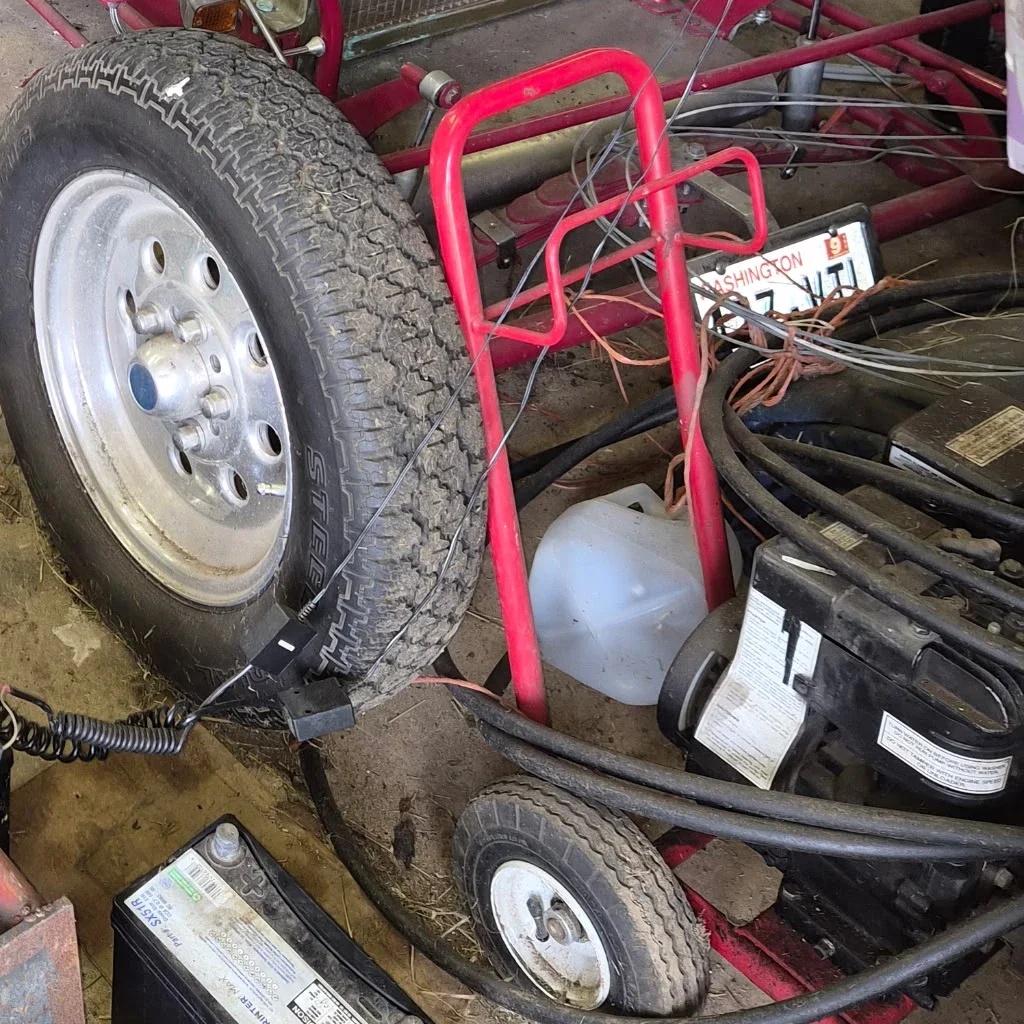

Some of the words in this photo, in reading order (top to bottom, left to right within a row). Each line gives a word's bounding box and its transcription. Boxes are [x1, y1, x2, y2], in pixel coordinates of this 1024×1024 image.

[828, 237, 843, 255] 9
[306, 446, 328, 595] STEE
[130, 895, 162, 929] SX51R
[165, 931, 182, 948] Part
